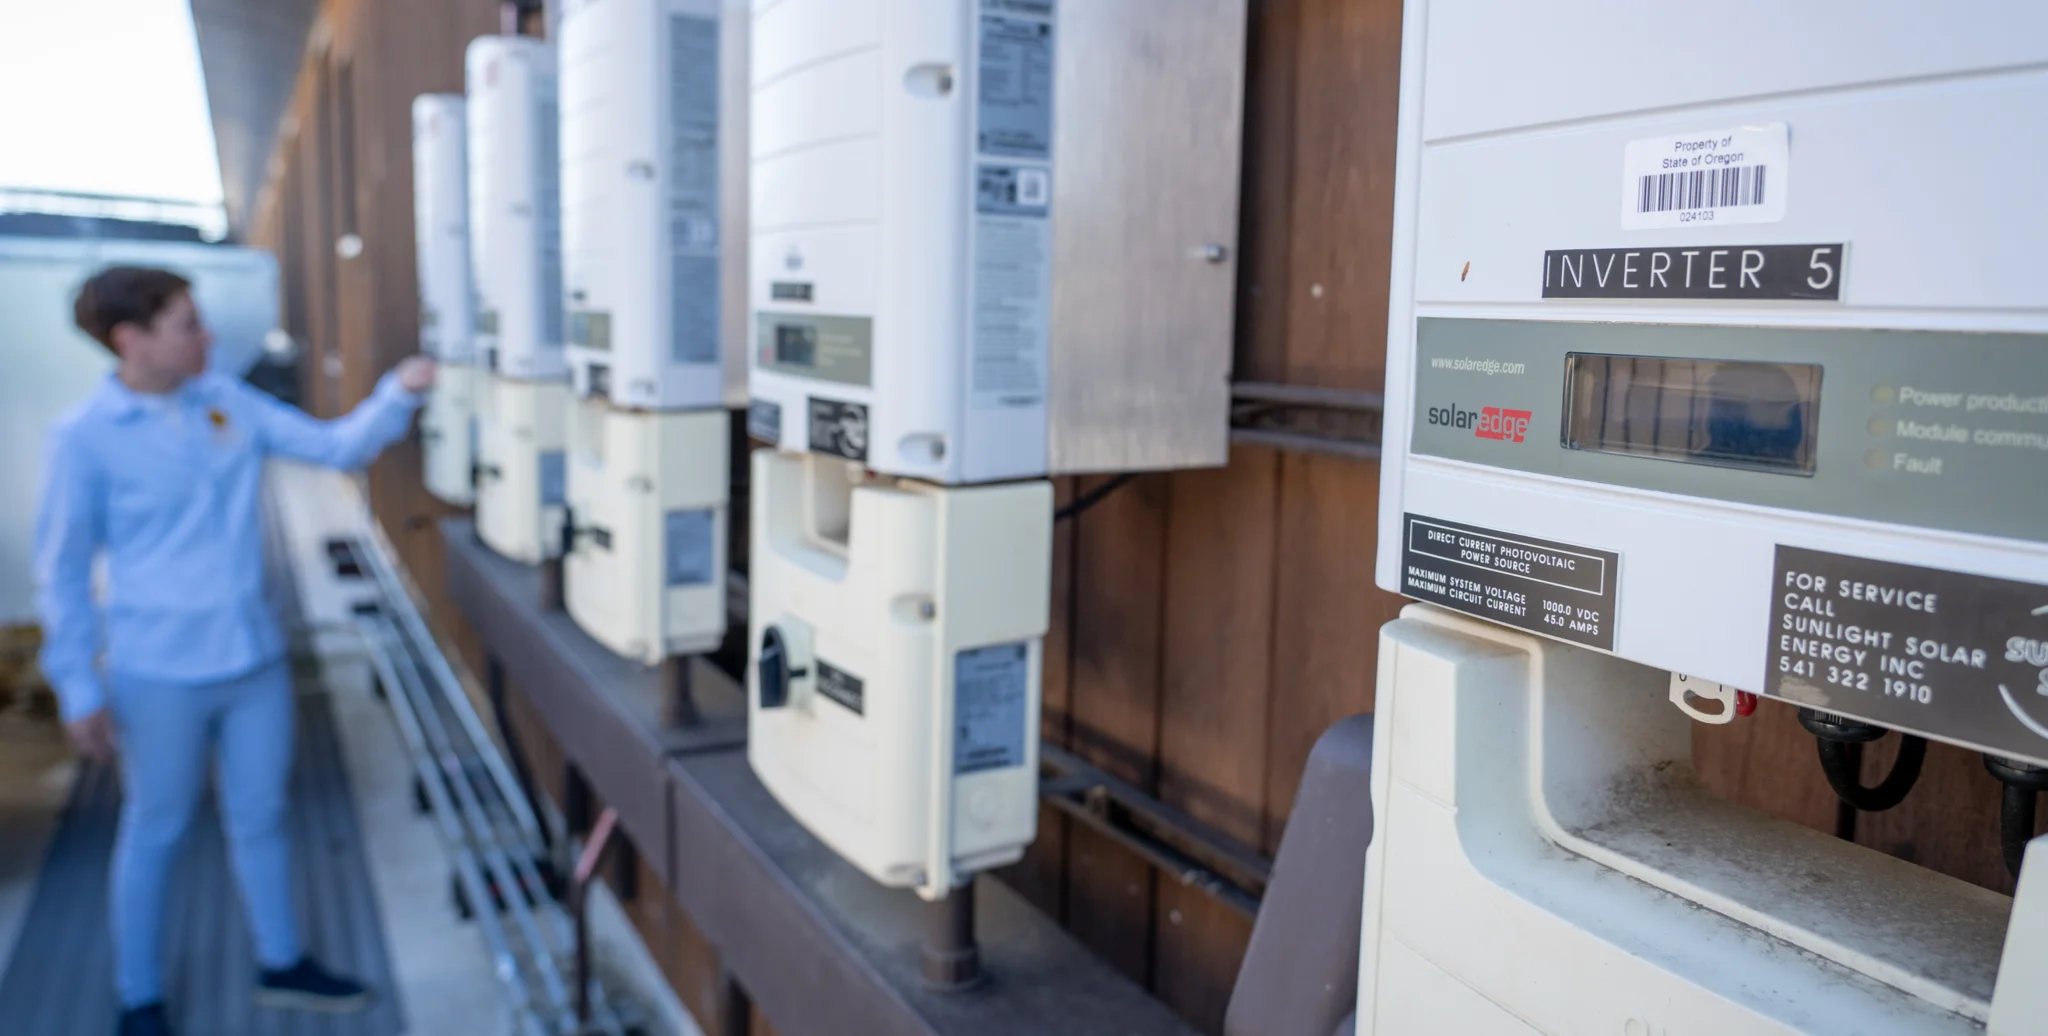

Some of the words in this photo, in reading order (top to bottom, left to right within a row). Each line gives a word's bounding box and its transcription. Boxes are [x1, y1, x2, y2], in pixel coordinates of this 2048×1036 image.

[1675, 138, 1718, 152] Property
[1721, 136, 1732, 147] of
[1662, 157, 1688, 169] State
[1692, 155, 1701, 166] of
[1705, 152, 1744, 165] Oregon
[1679, 211, 1714, 222] 024103
[1545, 250, 1765, 288] INVERTER
[1807, 248, 1833, 290] 5
[1431, 357, 1525, 376] www.solaredge.com
[1899, 386, 1963, 408] Power
[1428, 403, 1528, 443] solaredge
[1897, 420, 1969, 443] Module
[1894, 453, 1943, 474] Fault
[1428, 530, 1455, 545] DIRECT
[1459, 537, 1496, 553] CURRENT
[1500, 546, 1576, 570] PHOTOVOLTAIC
[1461, 549, 1490, 564] POWER
[1494, 556, 1531, 574] SOURCE
[1407, 577, 1446, 595] MAXIMUM
[1449, 588, 1482, 605] CIRCUIT
[1486, 598, 1527, 617] CURRENT
[1543, 613, 1564, 627] 45.0
[1569, 620, 1599, 636] AMPS
[1408, 565, 1446, 584] MAXIMUM
[1450, 576, 1481, 593] SYSTEM
[1485, 585, 1526, 605] VOLTAGE
[1542, 600, 1572, 616] 1000.0
[1577, 607, 1600, 623] VDC
[1784, 593, 1835, 617] CALL
[1786, 571, 1827, 593] FOR
[1839, 580, 1938, 613] SERVICE
[1781, 635, 1867, 667] ENERGY
[1880, 655, 1925, 680] INC
[1783, 614, 1893, 649] SUNLIGHT
[1905, 637, 1987, 669] SOLAR
[1779, 656, 1815, 678] 541
[1827, 666, 1870, 691] 322
[1884, 678, 1932, 704] 1910
